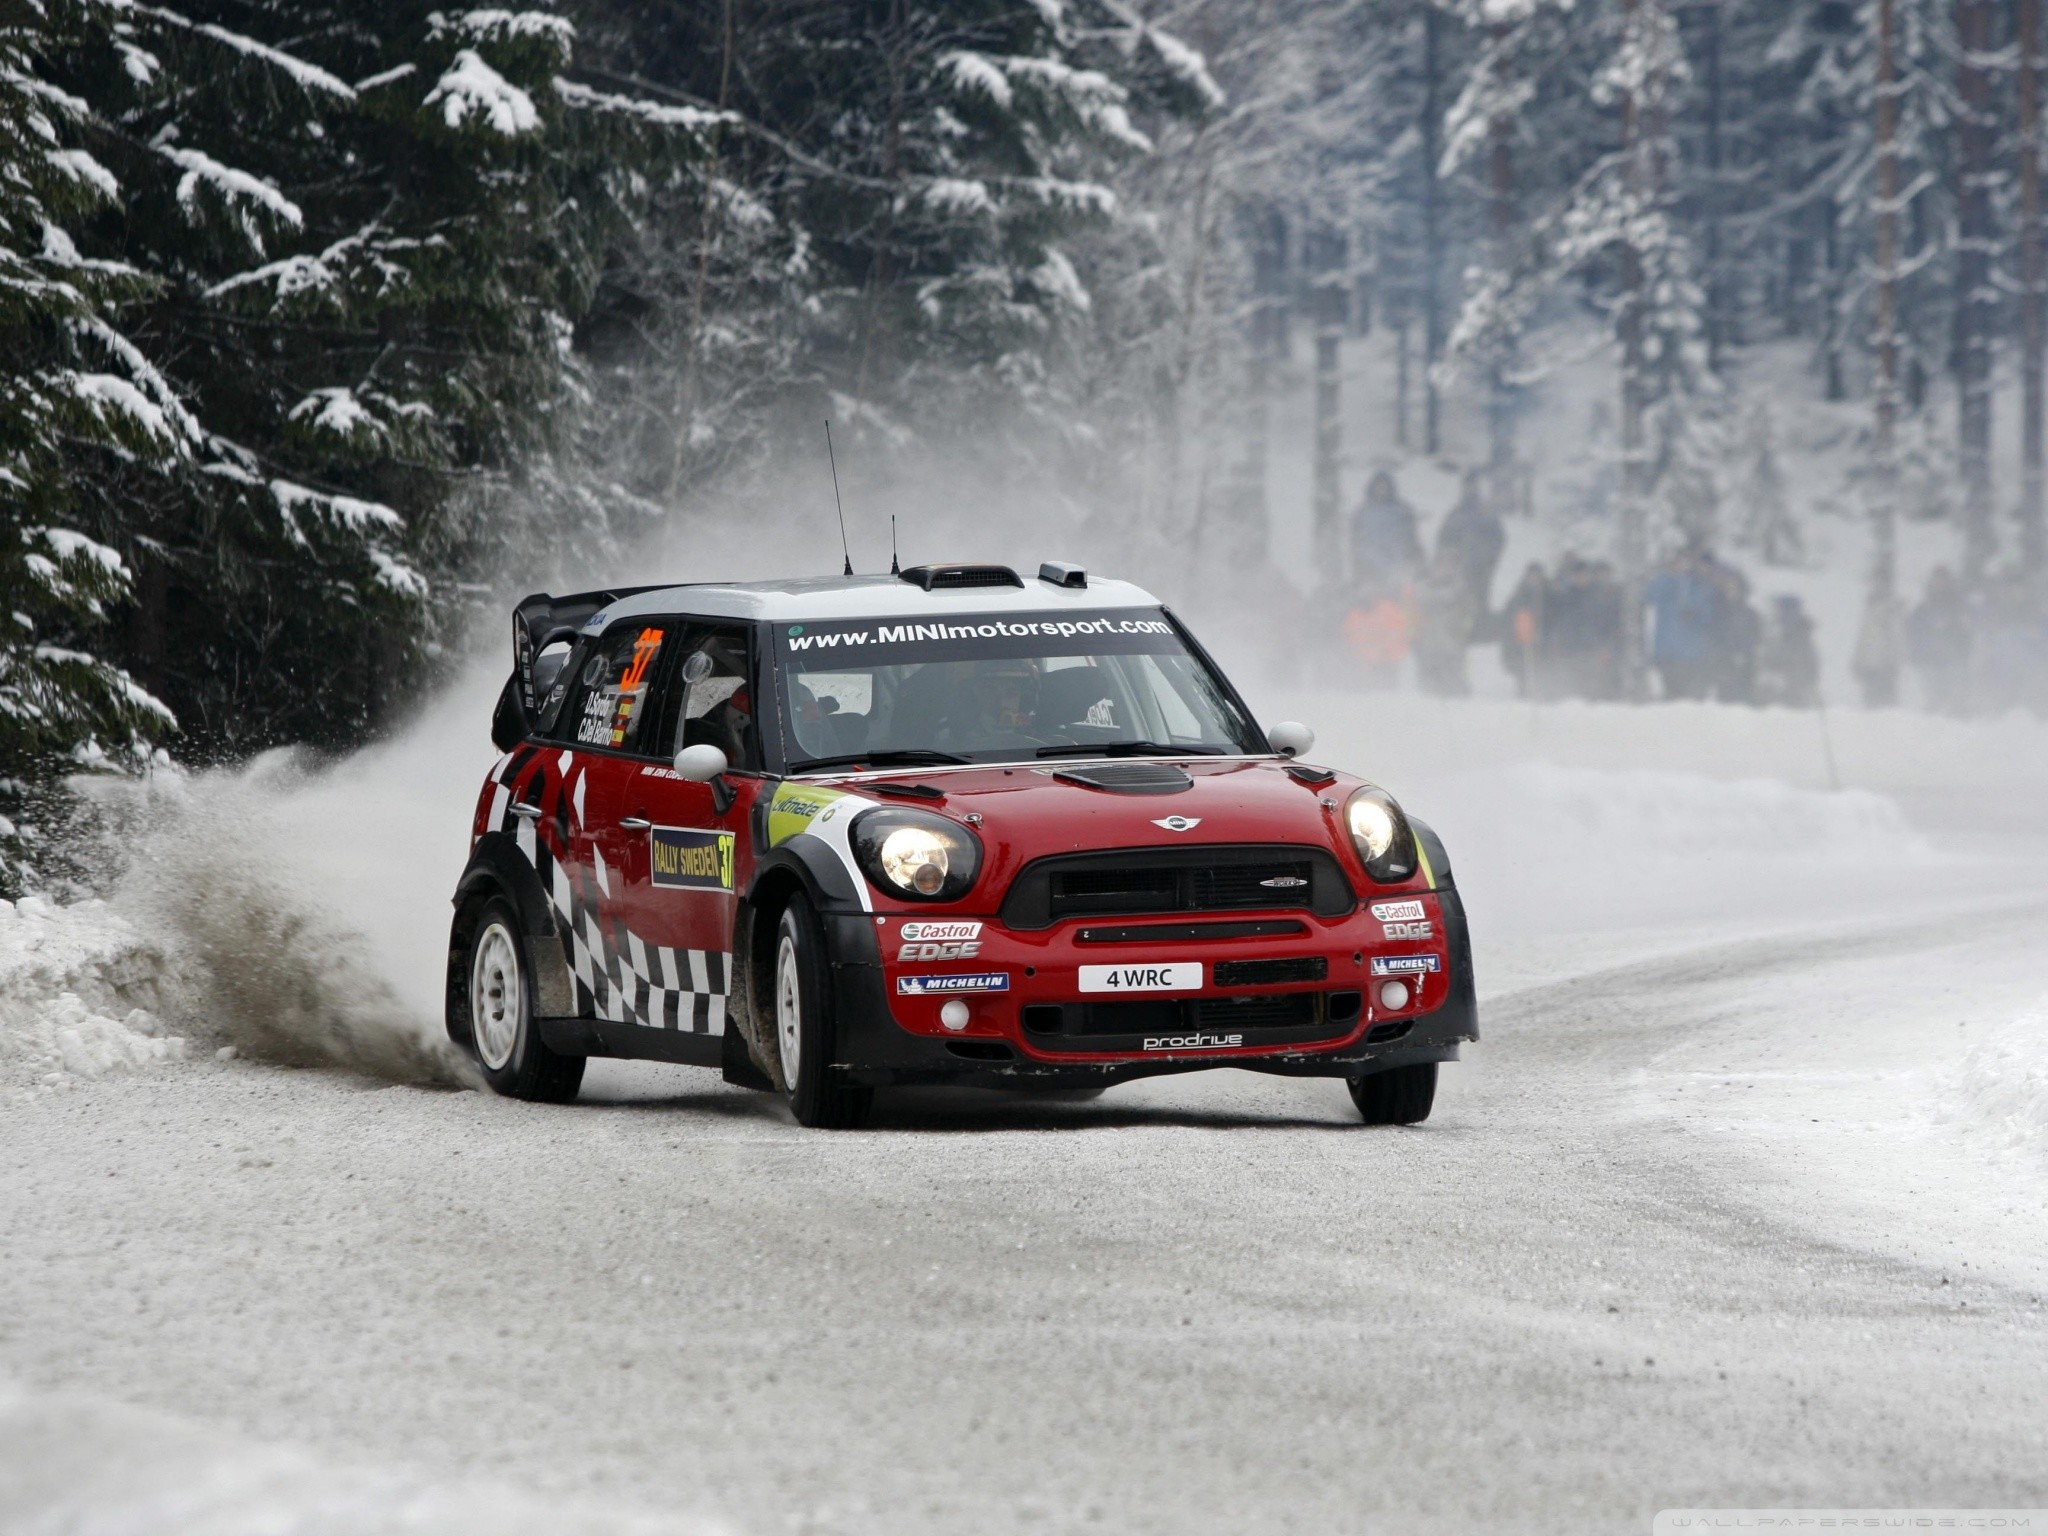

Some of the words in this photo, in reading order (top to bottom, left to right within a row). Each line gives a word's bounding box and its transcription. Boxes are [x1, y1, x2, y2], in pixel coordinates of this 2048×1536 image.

[788, 618, 1174, 651] www.MINImotorsport.com
[620, 627, 664, 693] 37
[654, 840, 679, 874] RALLY
[680, 844, 719, 877] SWEDEN
[718, 835, 734, 889] 37
[1385, 903, 1422, 919] Castrol
[920, 924, 976, 939] Castrol
[1383, 921, 1434, 940] EDGE
[896, 941, 984, 962] EDGE
[926, 976, 1004, 989] MICHELIN
[1106, 971, 1120, 987] 4
[1124, 969, 1172, 987] WRC
[1143, 1033, 1243, 1050] prodrive
